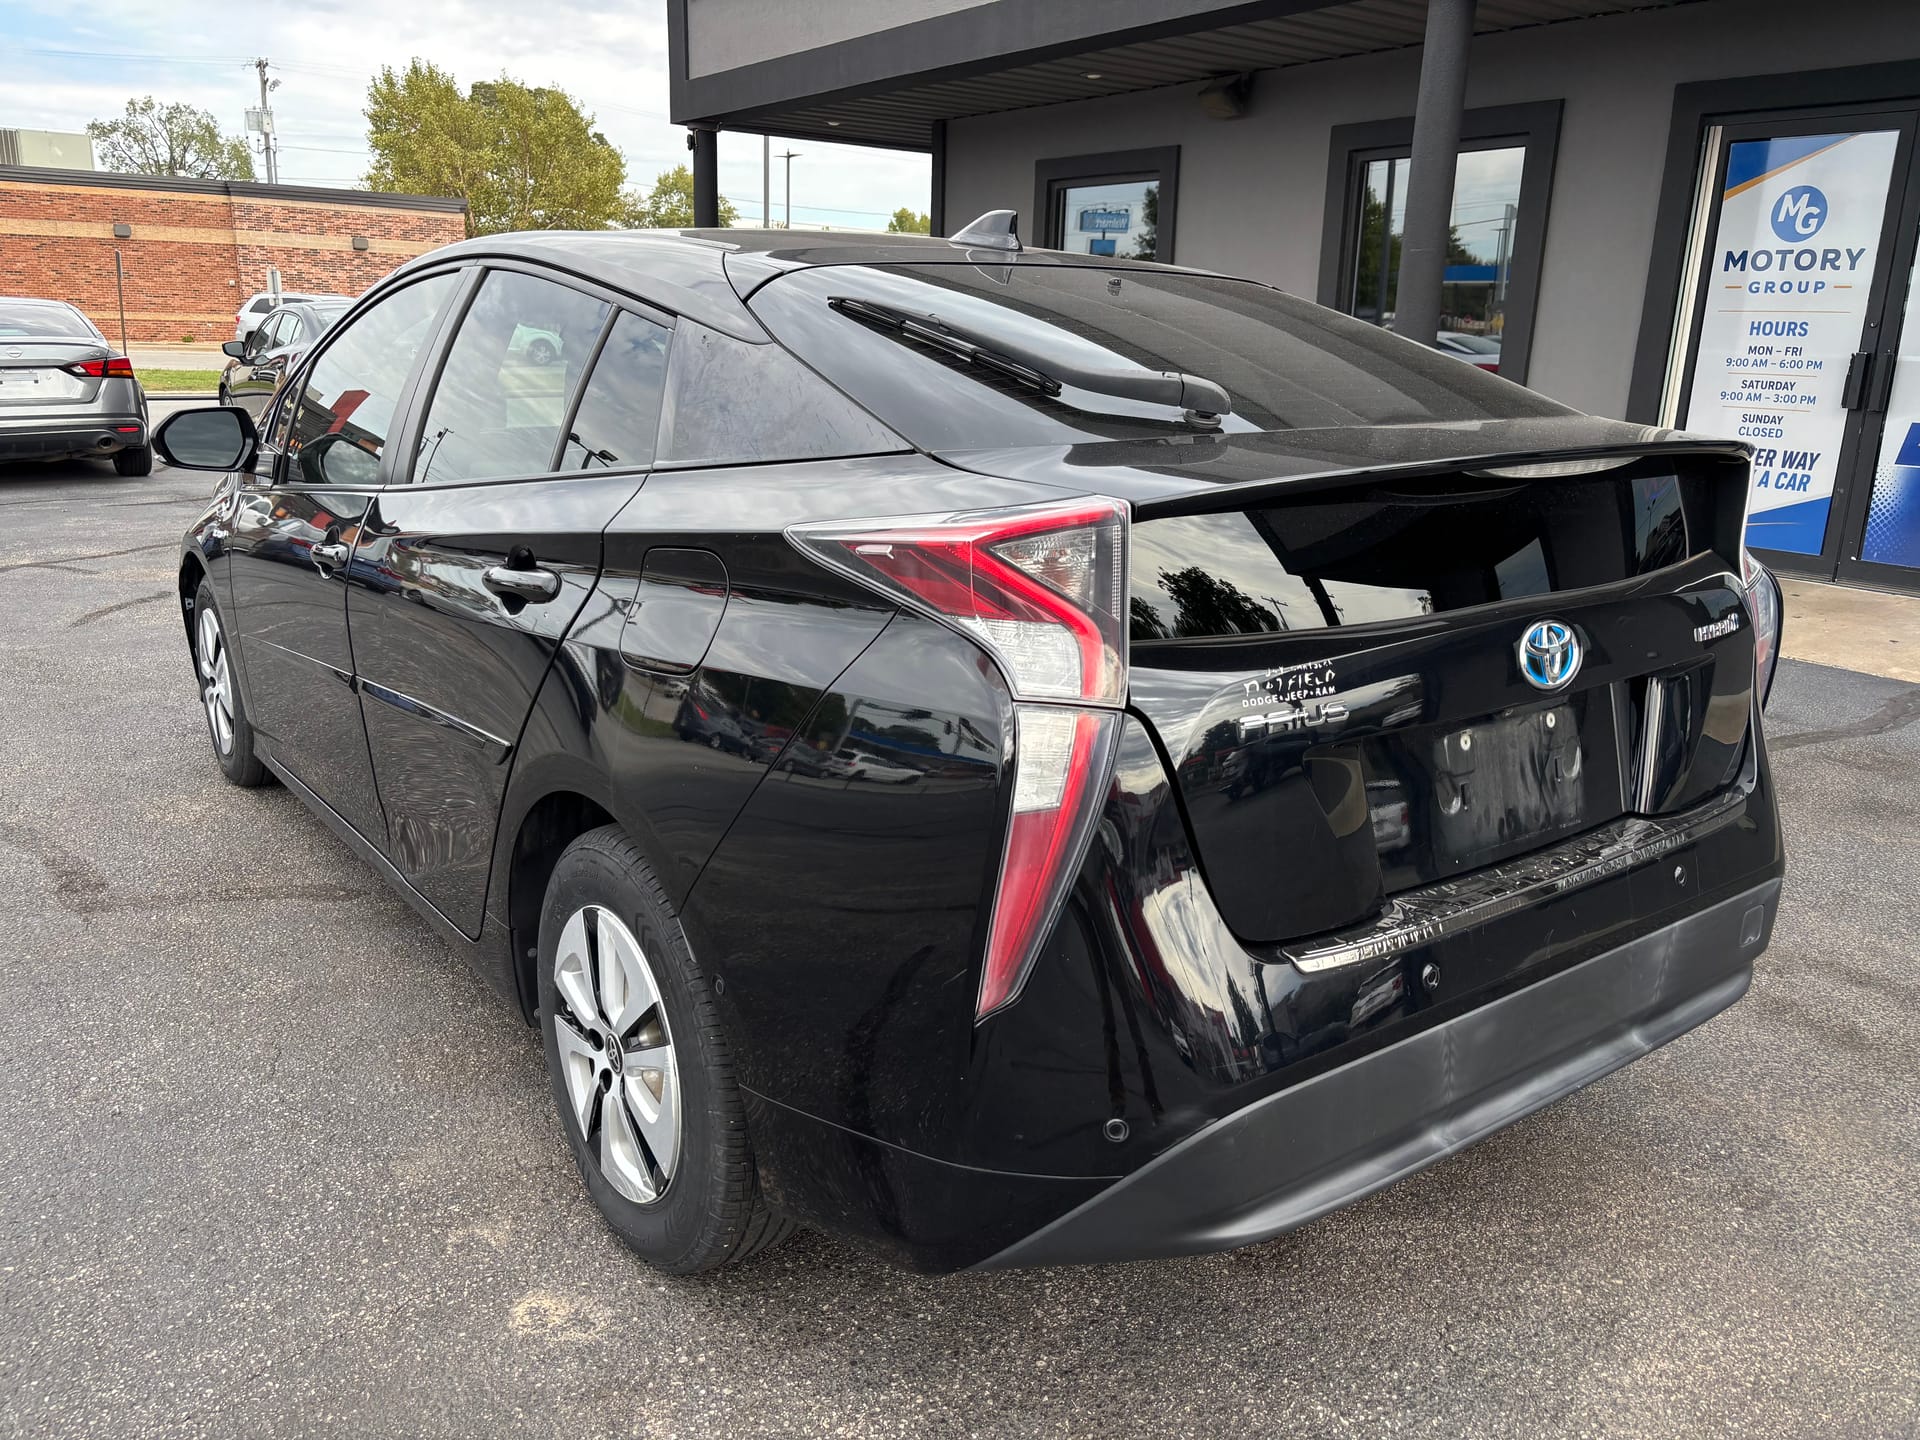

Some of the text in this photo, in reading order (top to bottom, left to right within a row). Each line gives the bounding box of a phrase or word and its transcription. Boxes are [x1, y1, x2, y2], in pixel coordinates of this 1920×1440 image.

[1777, 193, 1820, 235] MG
[1723, 248, 1866, 272] MOTORY
[1748, 281, 1826, 294] GROUP
[1749, 321, 1809, 337] HOURS
[1748, 345, 1773, 356] MON
[1784, 346, 1803, 357] FRI
[1726, 357, 1749, 368] 9:00
[1751, 359, 1768, 368] AM
[1779, 359, 1803, 369] 6:00
[1806, 360, 1823, 370] PM
[1741, 379, 1796, 391] SATURDAY
[1720, 391, 1743, 401] 9:00
[1745, 393, 1762, 402] AM
[1773, 394, 1797, 403] 3:00
[1800, 395, 1816, 405] PM
[1741, 413, 1784, 425] SUNDAY
[1738, 426, 1783, 438] CLOSED
[1754, 448, 1821, 471] ER WAY
[1757, 470, 1811, 492] A CAR
